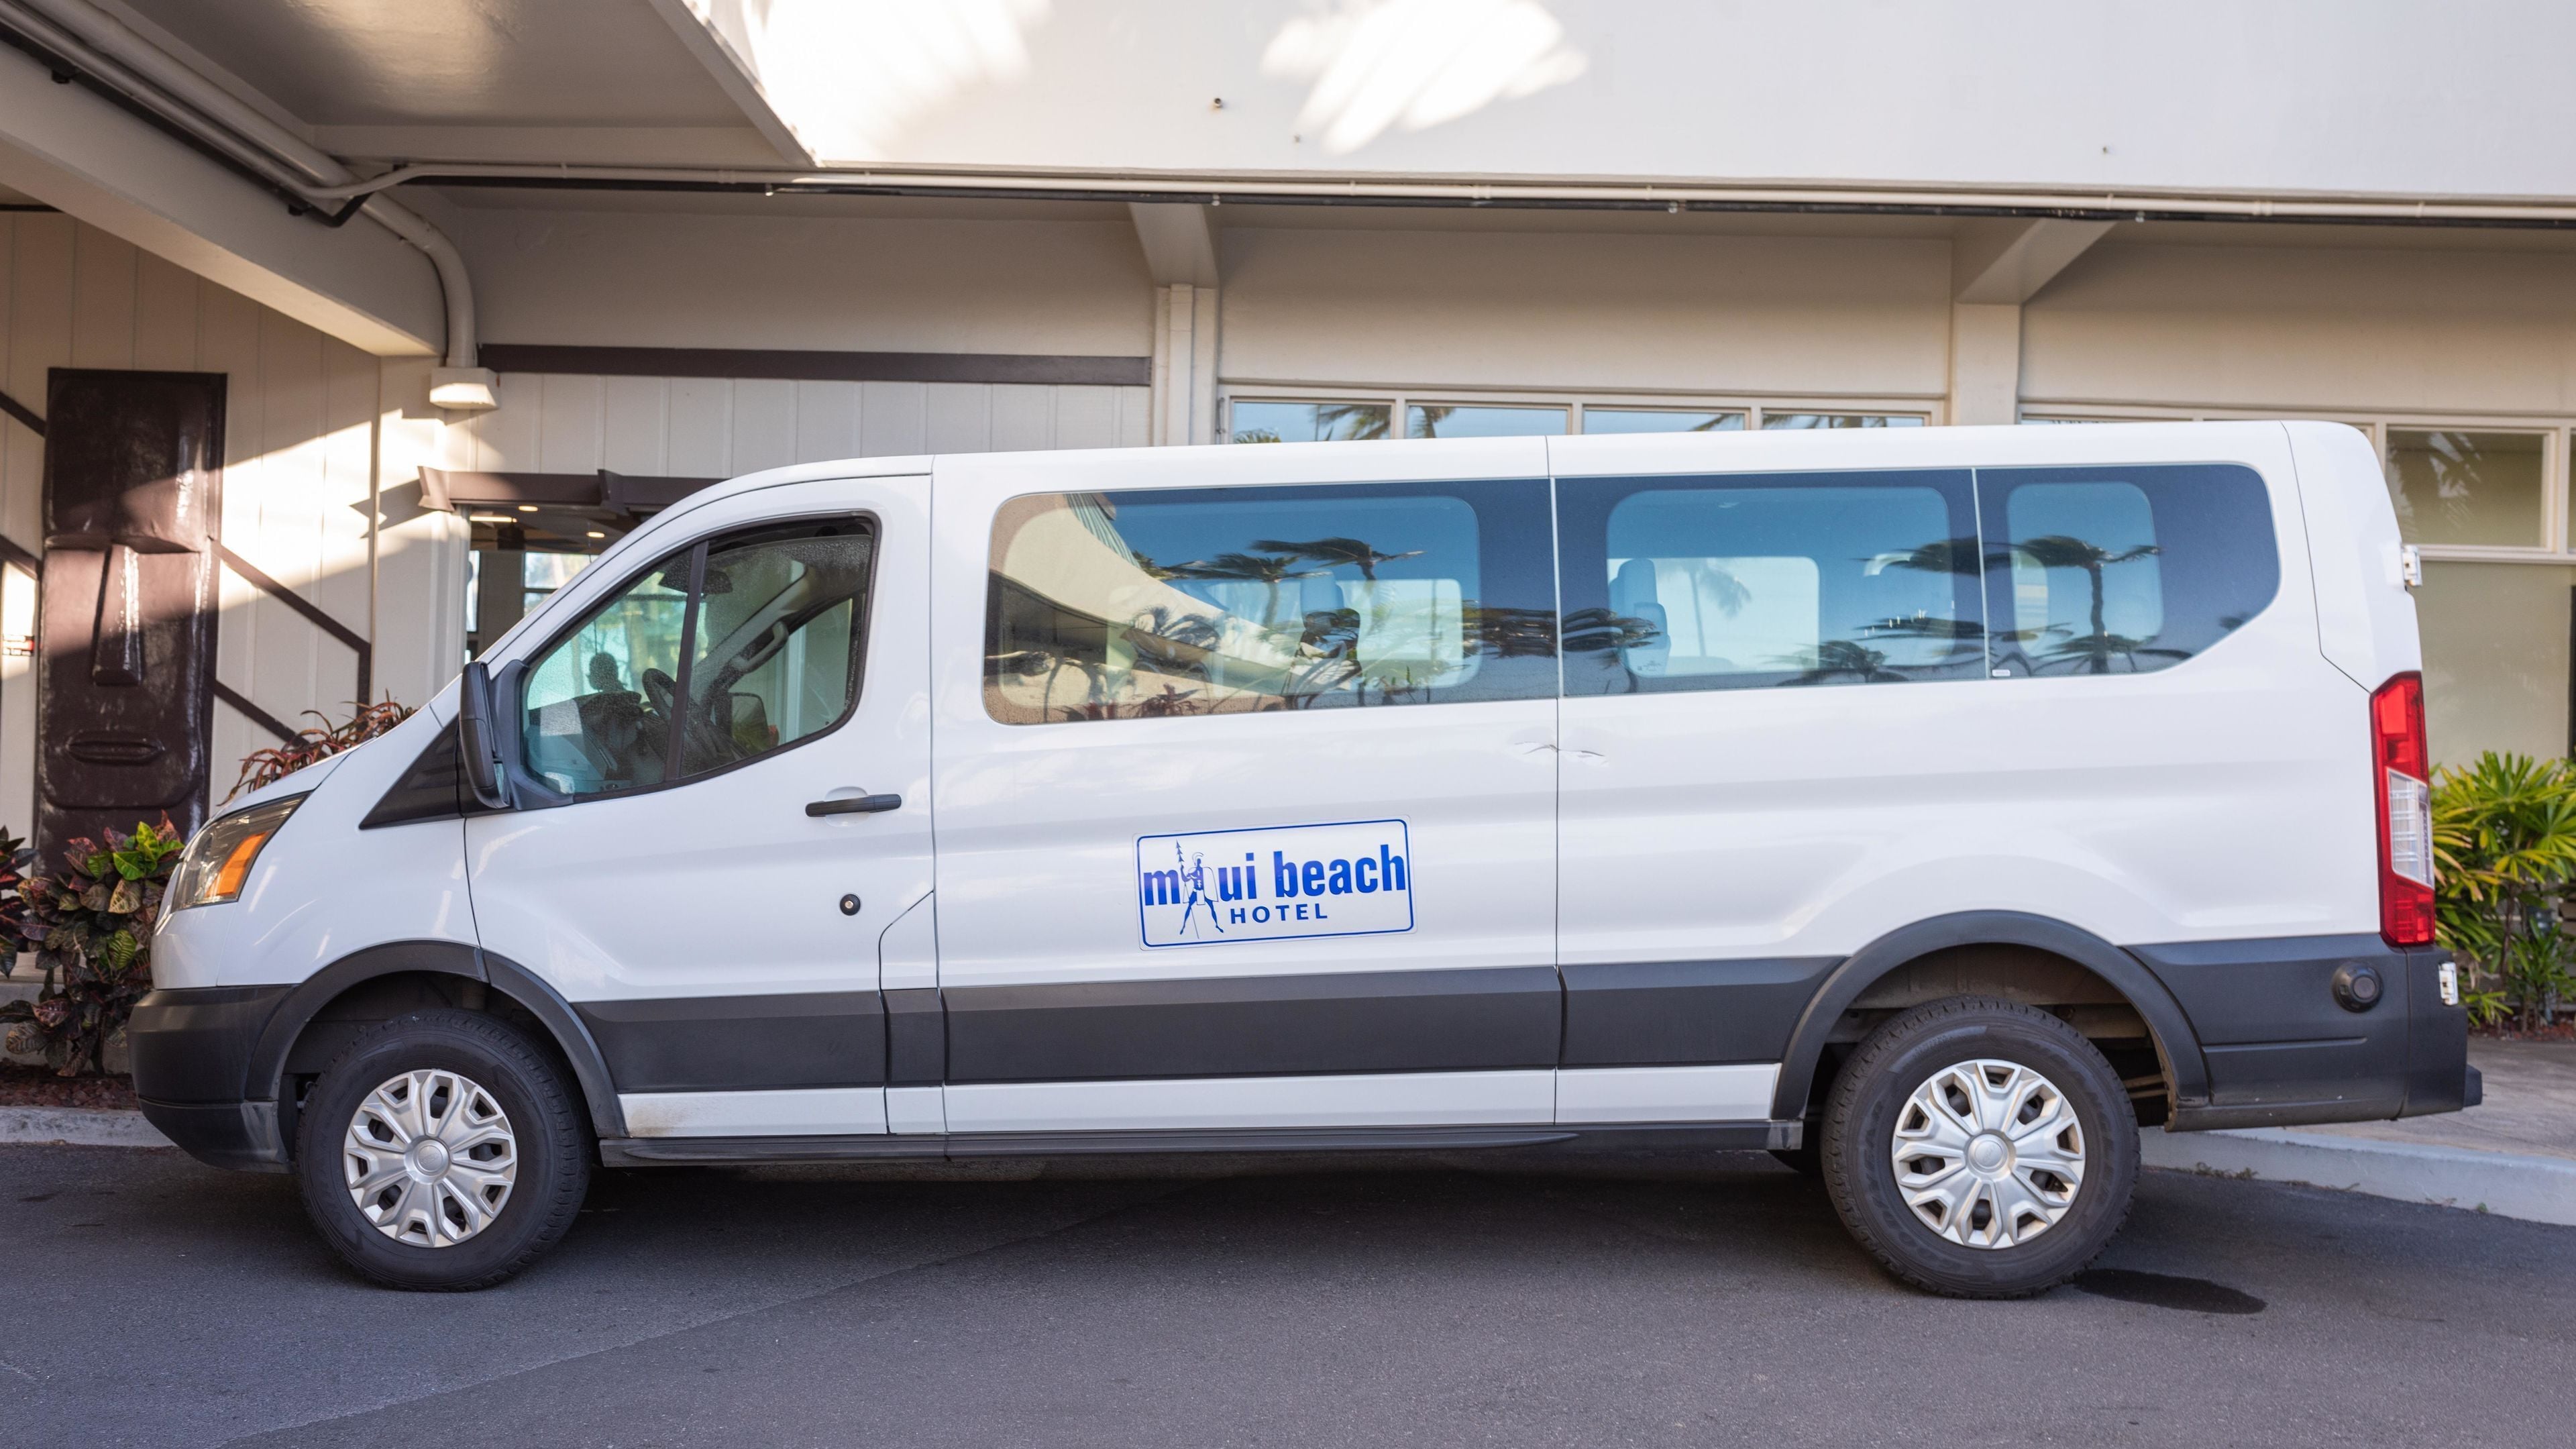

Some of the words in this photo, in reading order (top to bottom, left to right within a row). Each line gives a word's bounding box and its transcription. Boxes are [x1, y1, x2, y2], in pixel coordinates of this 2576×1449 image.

[1143, 852, 1257, 906] mui
[1273, 844, 1406, 898] beach
[1230, 903, 1328, 924] HOTEL
